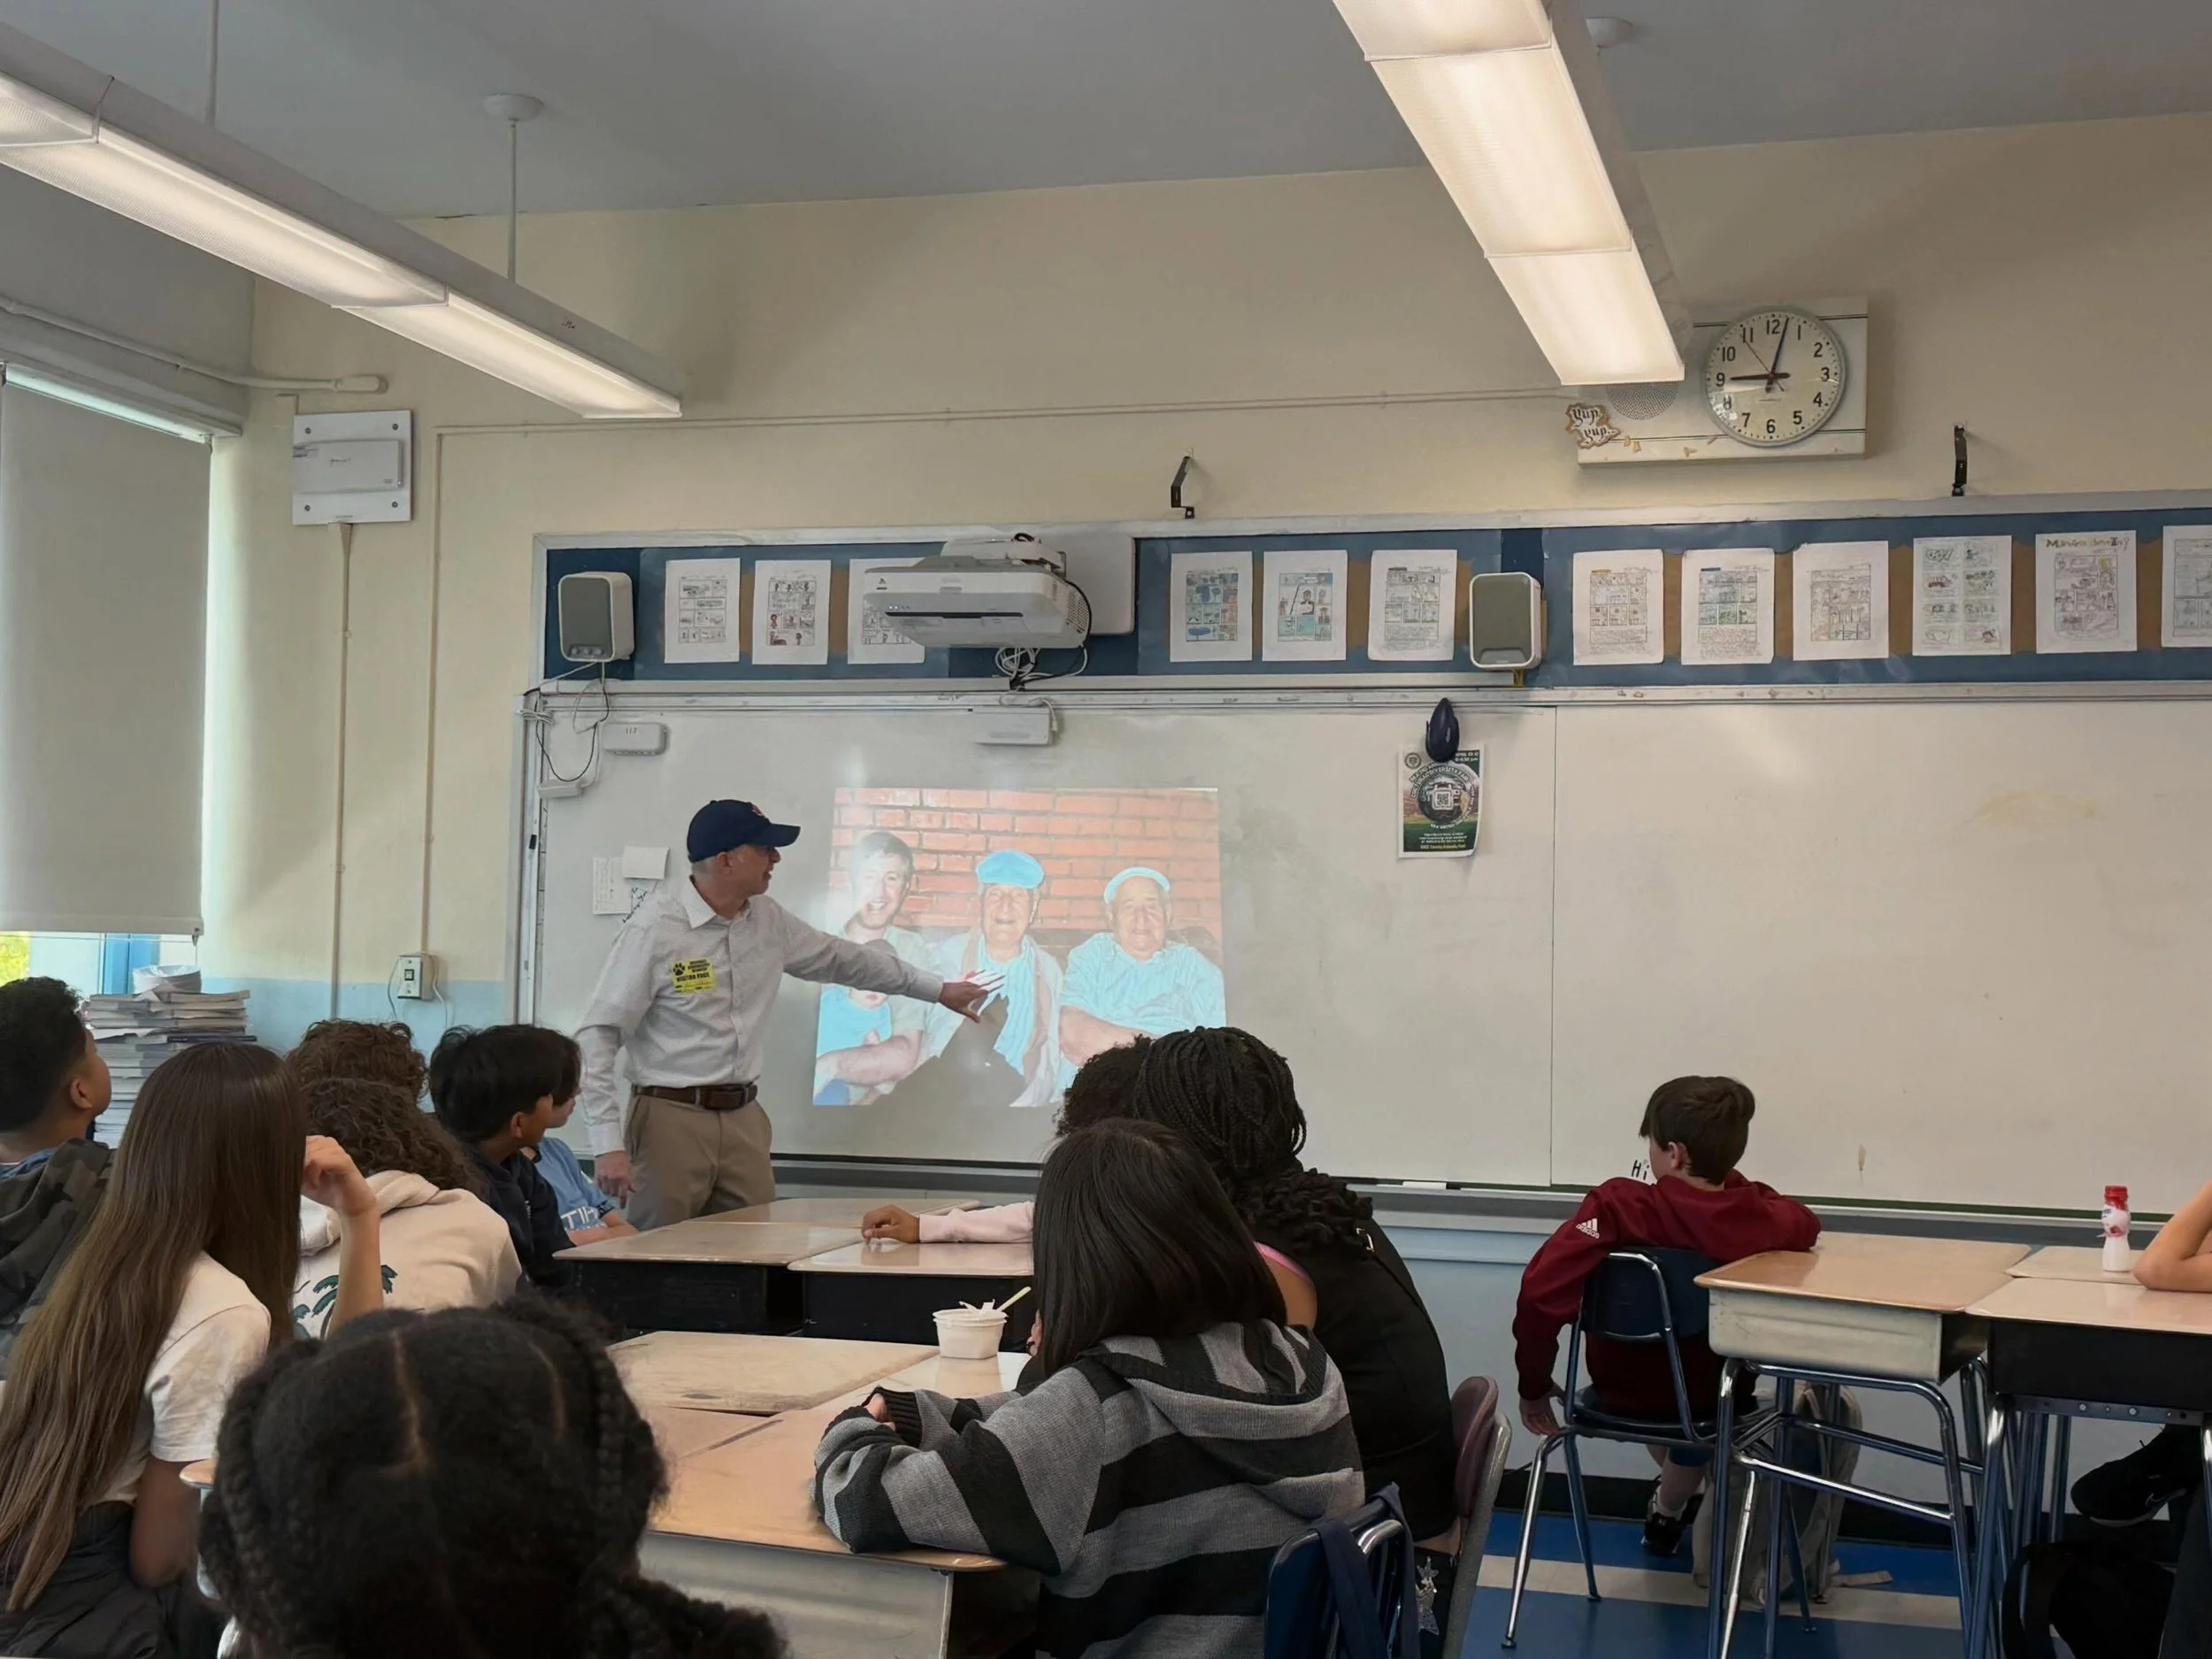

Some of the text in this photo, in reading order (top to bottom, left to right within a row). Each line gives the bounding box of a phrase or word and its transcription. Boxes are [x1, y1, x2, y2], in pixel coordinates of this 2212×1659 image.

[1766, 319, 1780, 334] 12
[1797, 325, 1801, 341] 1
[1742, 327, 1754, 343] 11
[1722, 346, 1736, 362] 10
[1813, 342, 1824, 358] 2
[1716, 373, 1725, 387] 9
[1820, 367, 1830, 381] 3
[1723, 395, 1732, 411] 8
[1812, 392, 1823, 407] 4
[1741, 412, 1751, 427] 7
[1793, 411, 1802, 425] 5
[1766, 419, 1776, 434] 6
[1631, 1159, 1650, 1180] Hi
[1576, 1224, 1600, 1239] adidas
